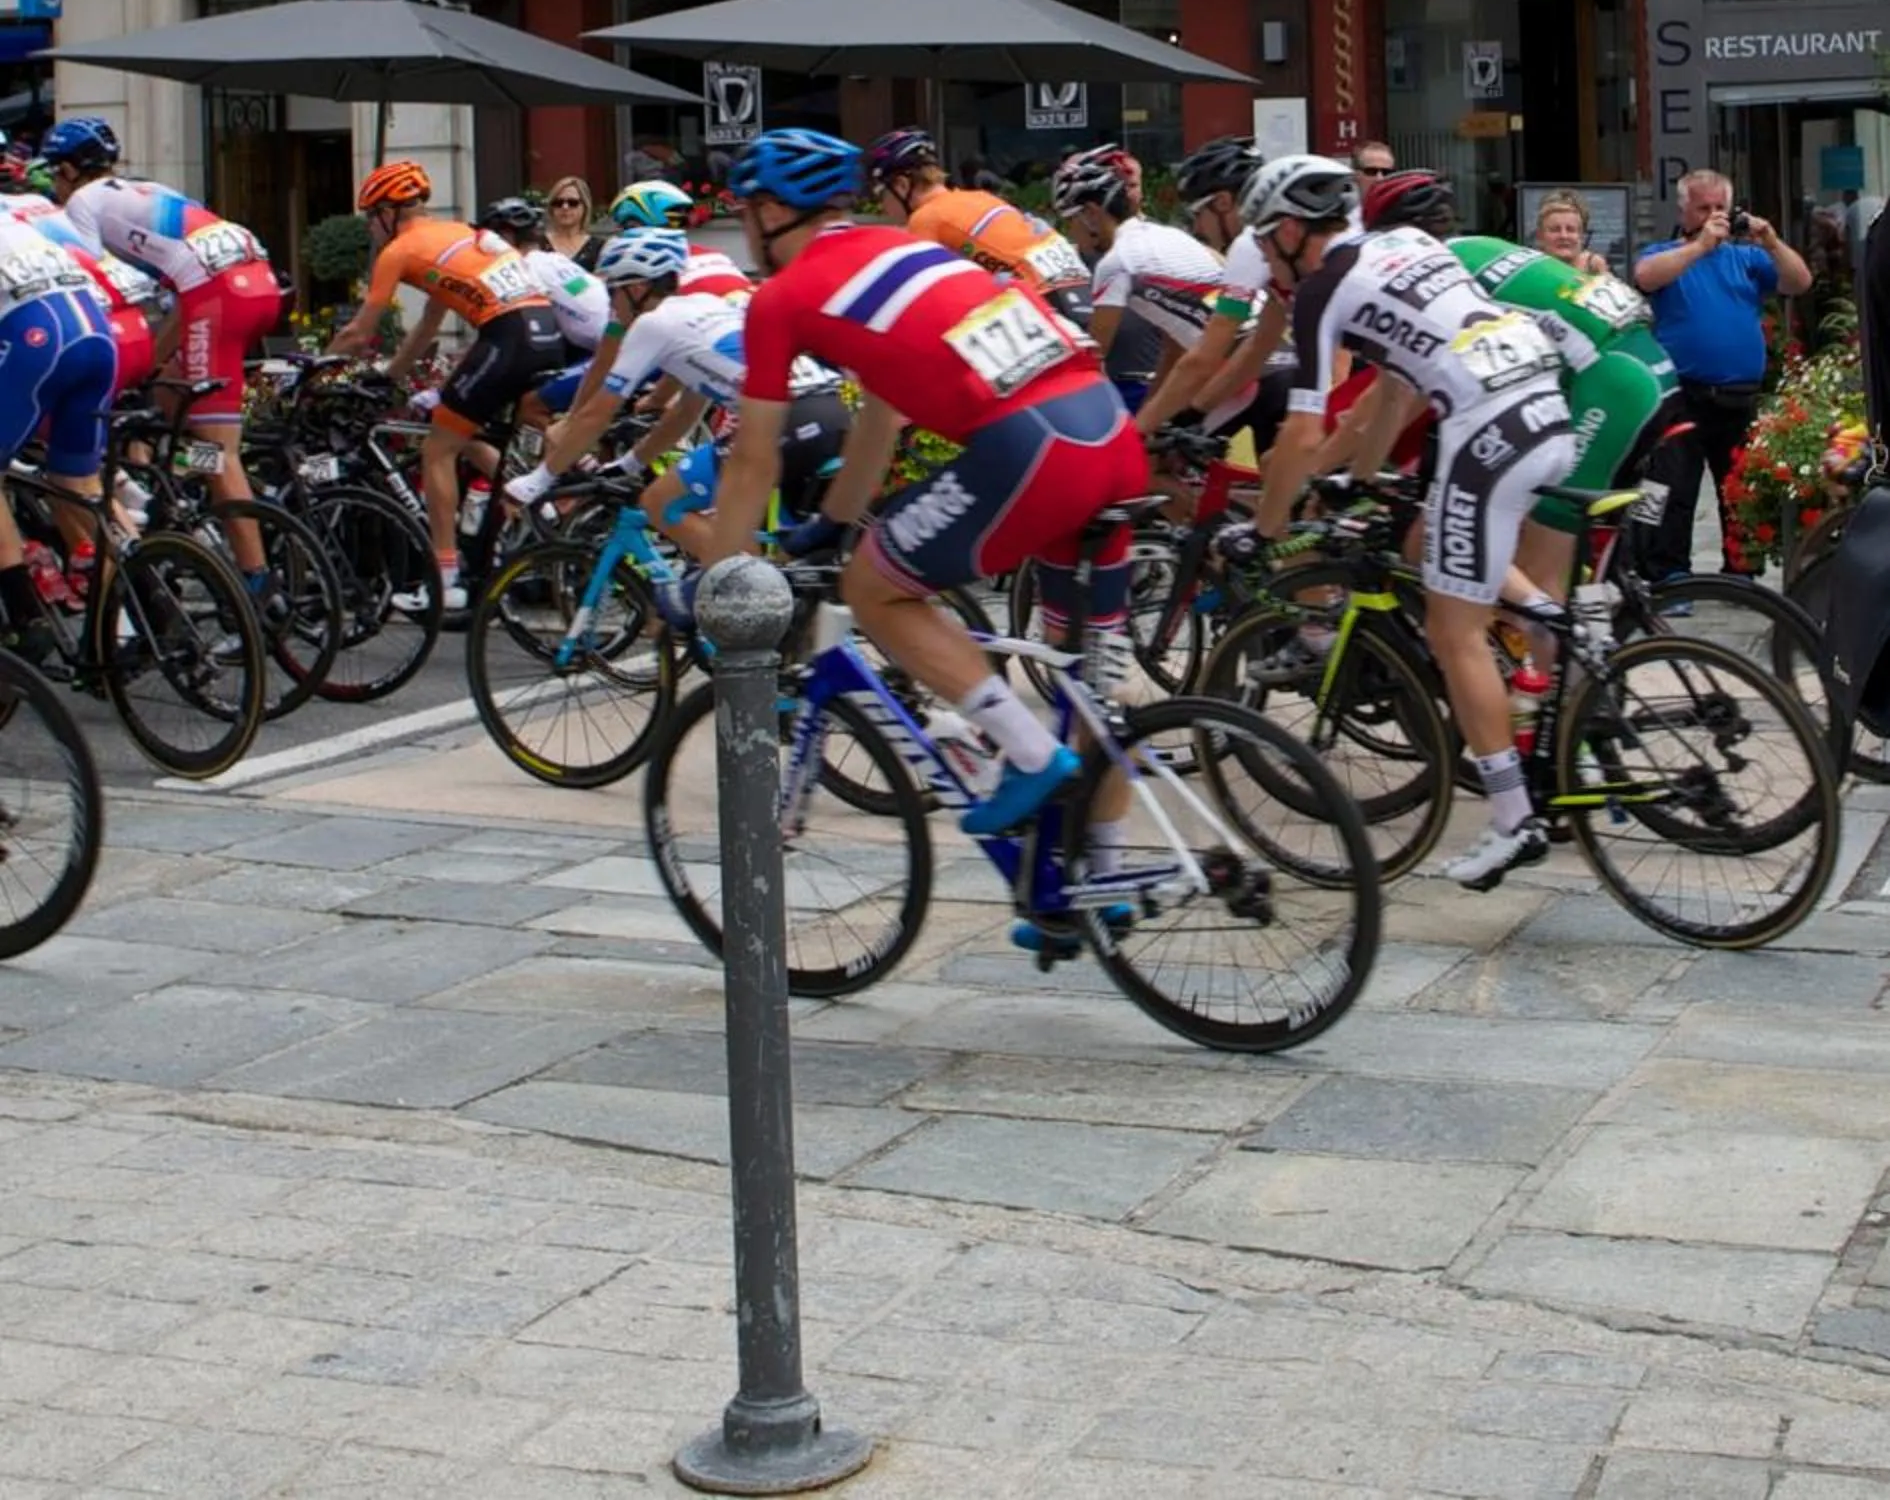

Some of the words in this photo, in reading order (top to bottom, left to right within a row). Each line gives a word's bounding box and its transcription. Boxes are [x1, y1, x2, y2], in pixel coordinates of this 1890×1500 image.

[1704, 30, 1883, 59] RESTAURANT
[1339, 120, 1357, 138] H
[188, 318, 210, 380] USSIA
[966, 307, 1044, 371] 174
